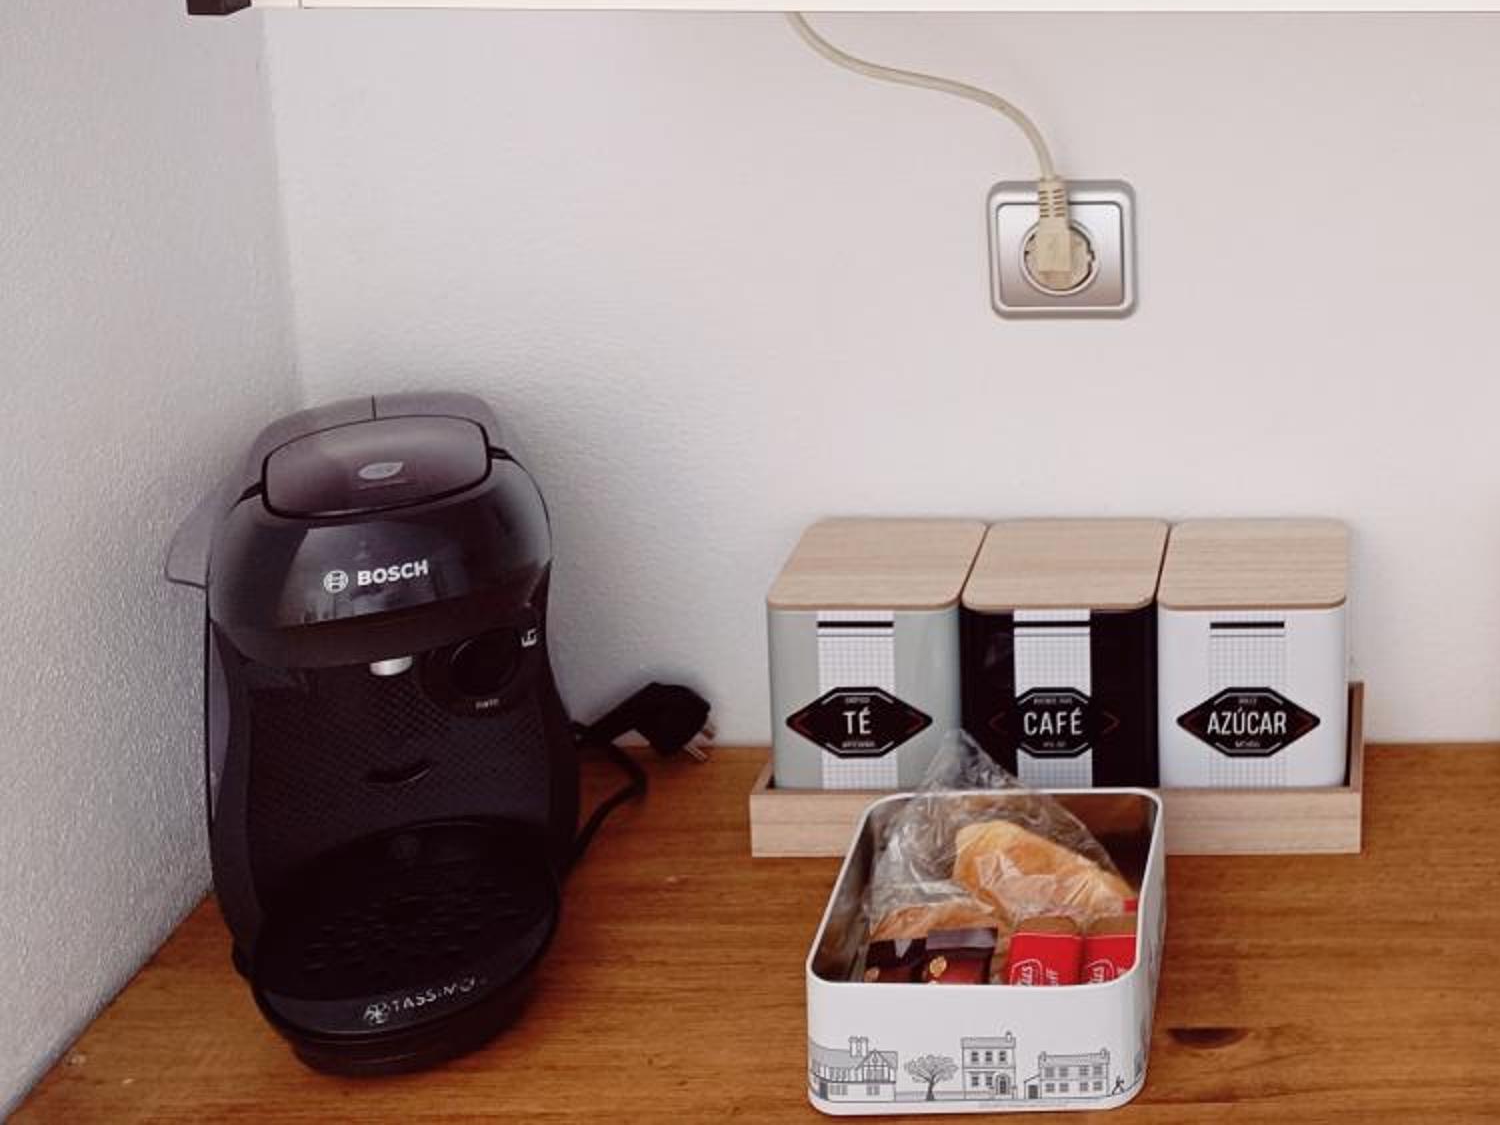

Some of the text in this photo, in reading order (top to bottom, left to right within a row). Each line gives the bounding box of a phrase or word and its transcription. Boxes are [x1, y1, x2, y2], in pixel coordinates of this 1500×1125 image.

[357, 559, 428, 586] BOSCH
[843, 706, 871, 735] TÉ
[1023, 707, 1082, 735] CAFÉ
[1207, 708, 1287, 735] AZÚCAR
